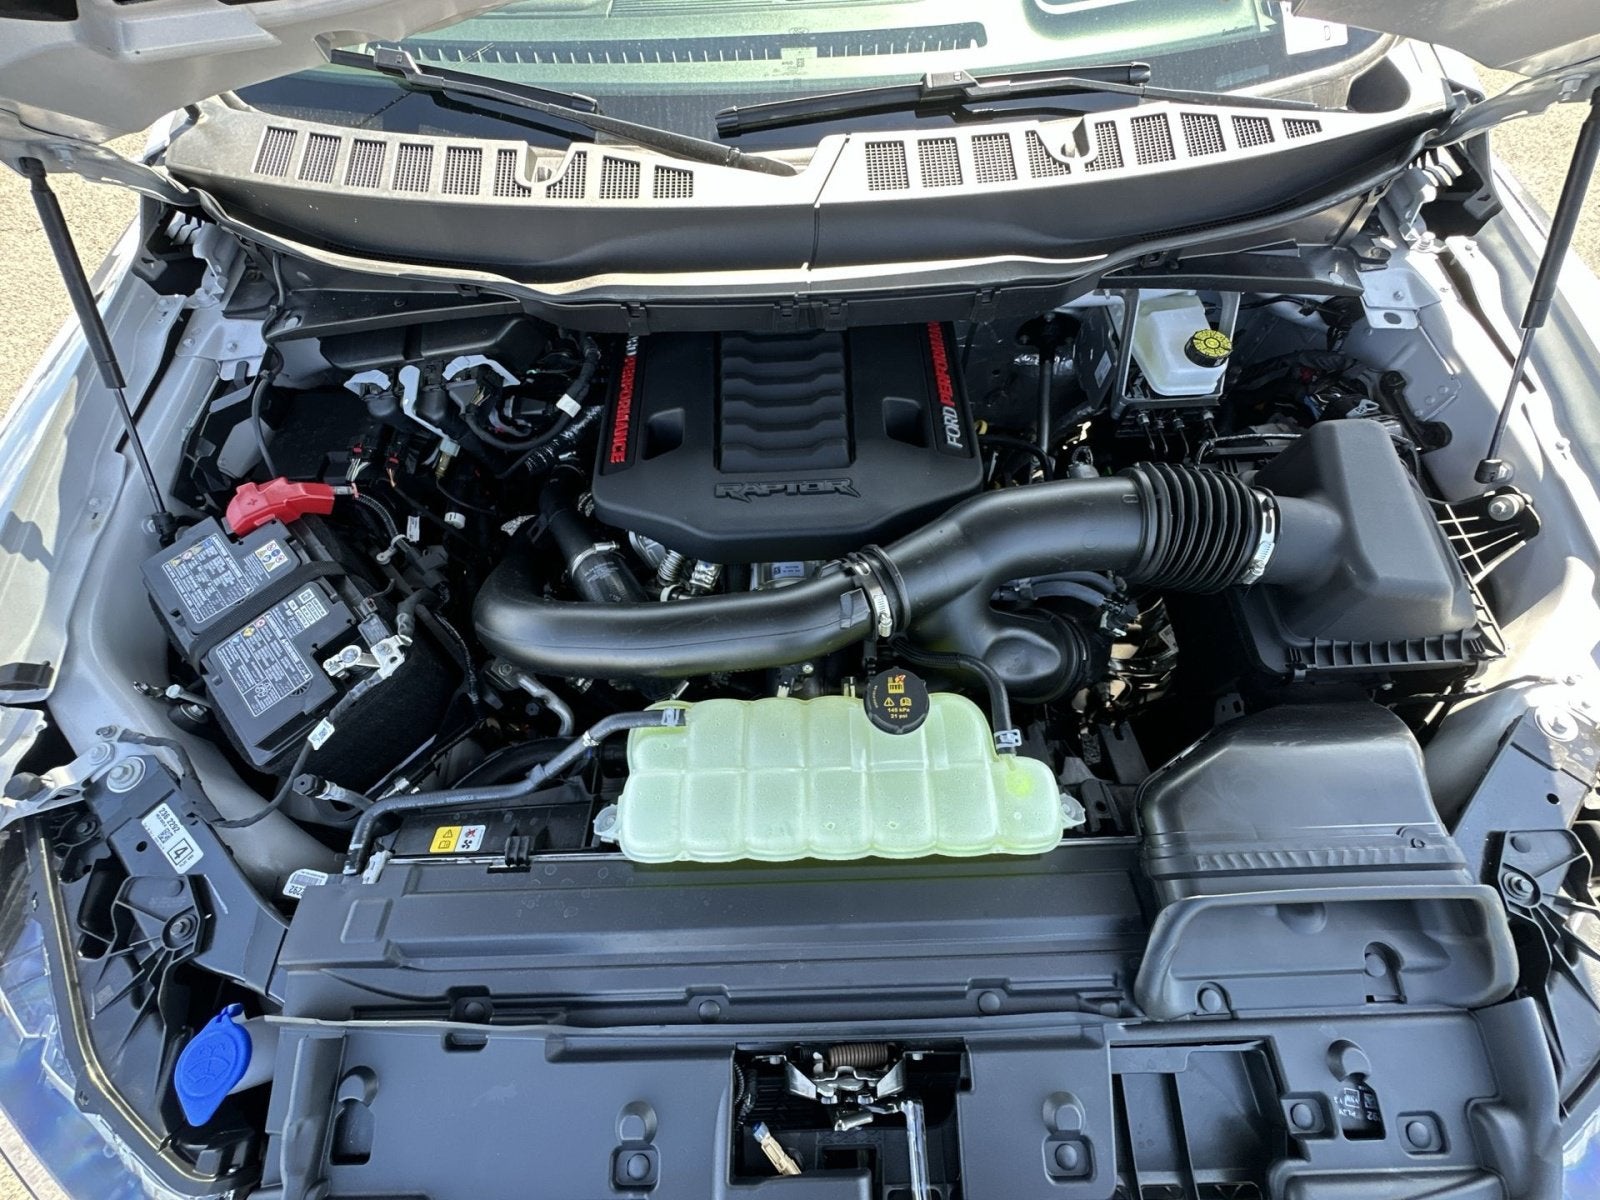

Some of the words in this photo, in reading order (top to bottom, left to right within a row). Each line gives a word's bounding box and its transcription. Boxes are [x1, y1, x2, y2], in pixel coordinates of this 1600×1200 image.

[610, 356, 637, 463] PERFORMANCE
[942, 405, 963, 448] FORD
[714, 477, 861, 503] RAPTOR
[174, 846, 189, 860] 4
